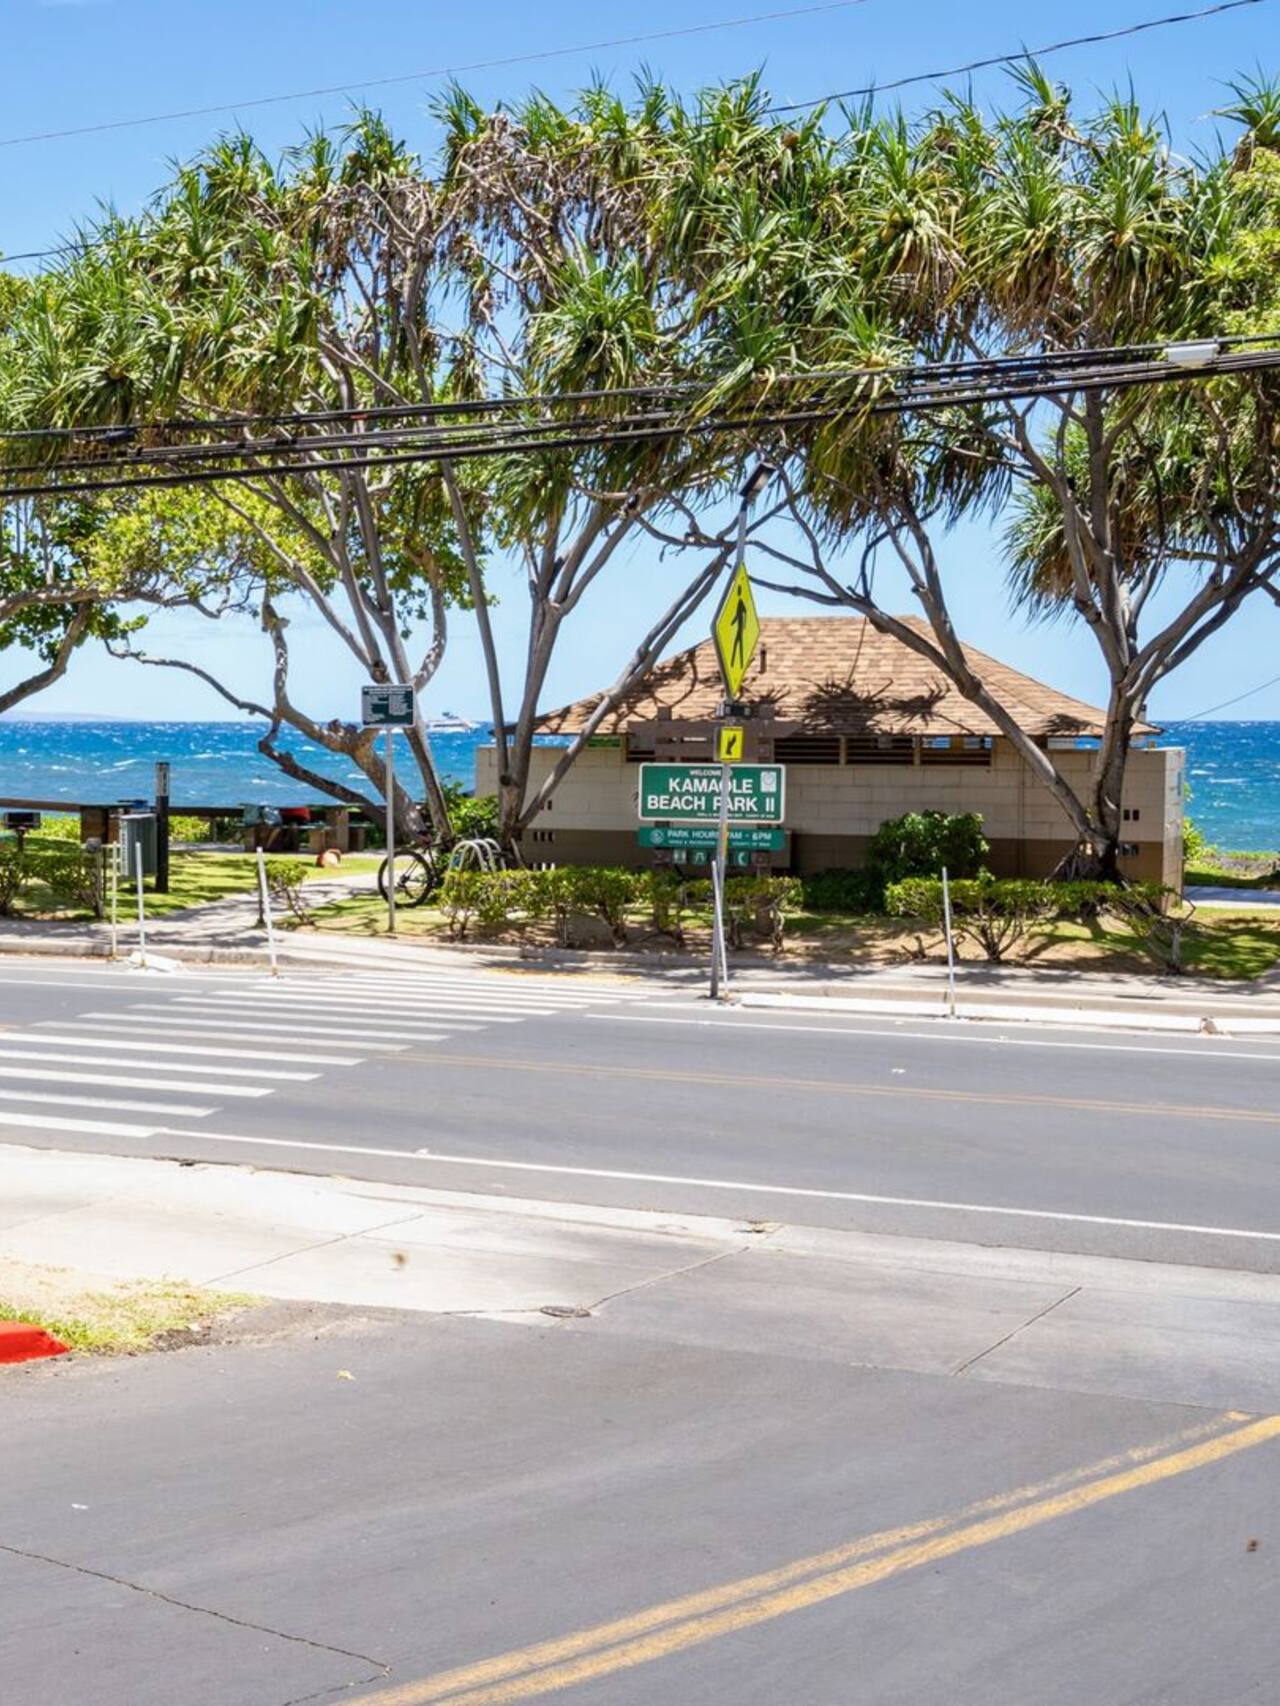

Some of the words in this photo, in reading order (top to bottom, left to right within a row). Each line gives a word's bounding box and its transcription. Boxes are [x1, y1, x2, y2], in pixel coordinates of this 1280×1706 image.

[689, 769, 722, 777] WELCOME
[647, 795, 706, 810] BEACH
[713, 796, 758, 812] PARK
[667, 829, 689, 838] PARK
[725, 831, 742, 840] AM
